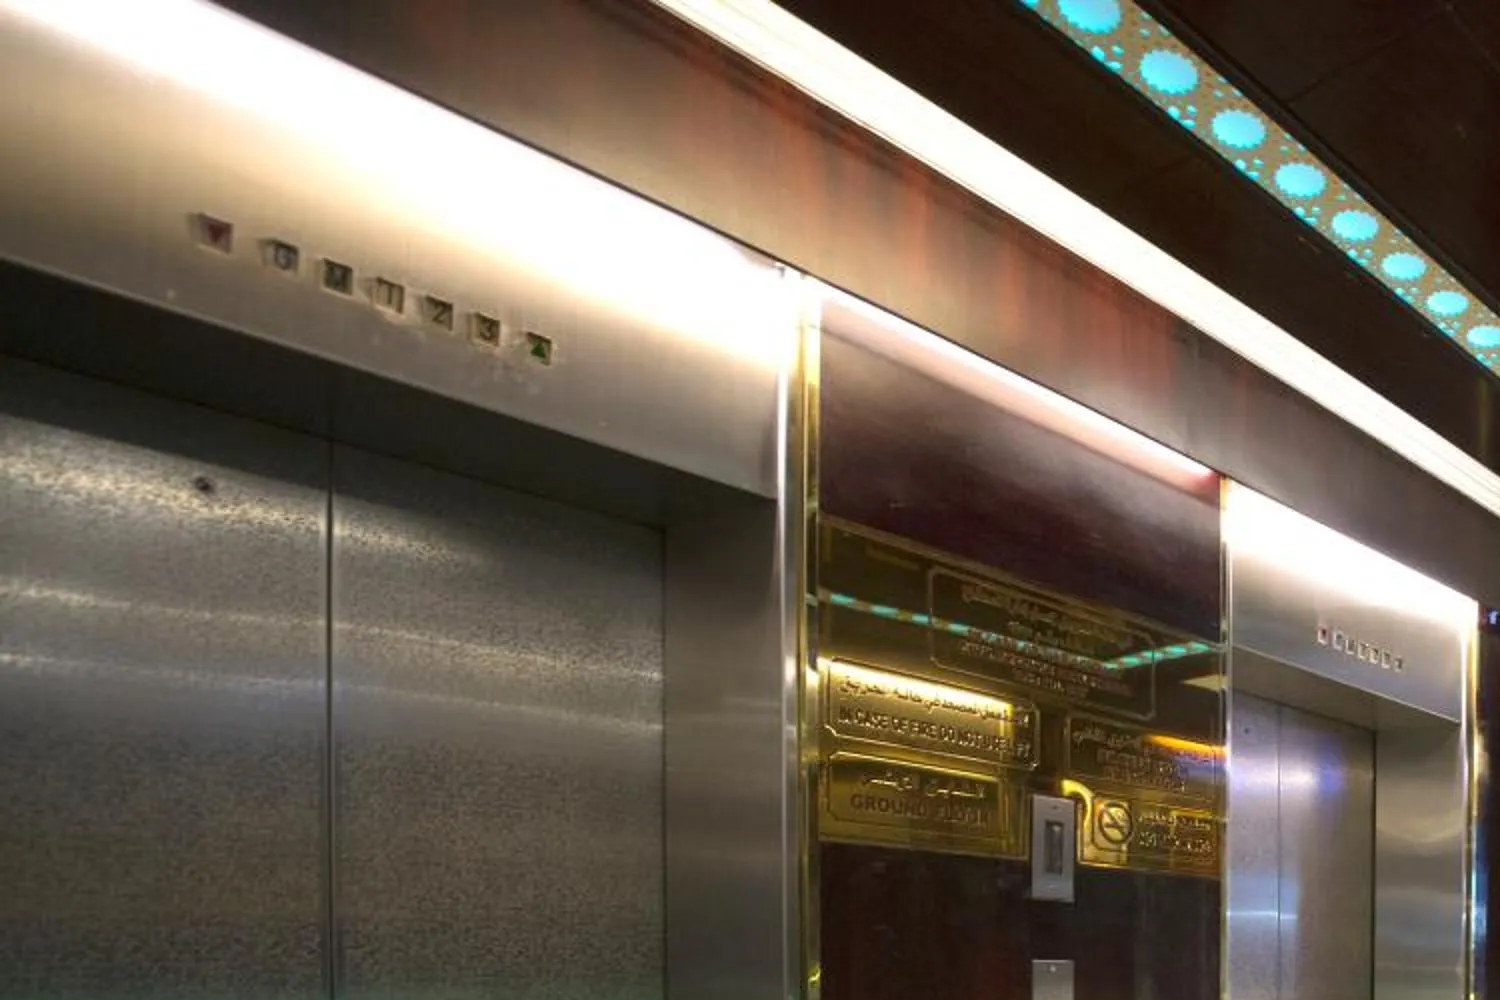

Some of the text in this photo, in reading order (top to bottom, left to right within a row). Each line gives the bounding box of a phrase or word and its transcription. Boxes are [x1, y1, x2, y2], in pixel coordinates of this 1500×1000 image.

[855, 708, 890, 731] CASE
[910, 719, 938, 739] FIRE
[851, 793, 991, 827] GROUND FLOOR
